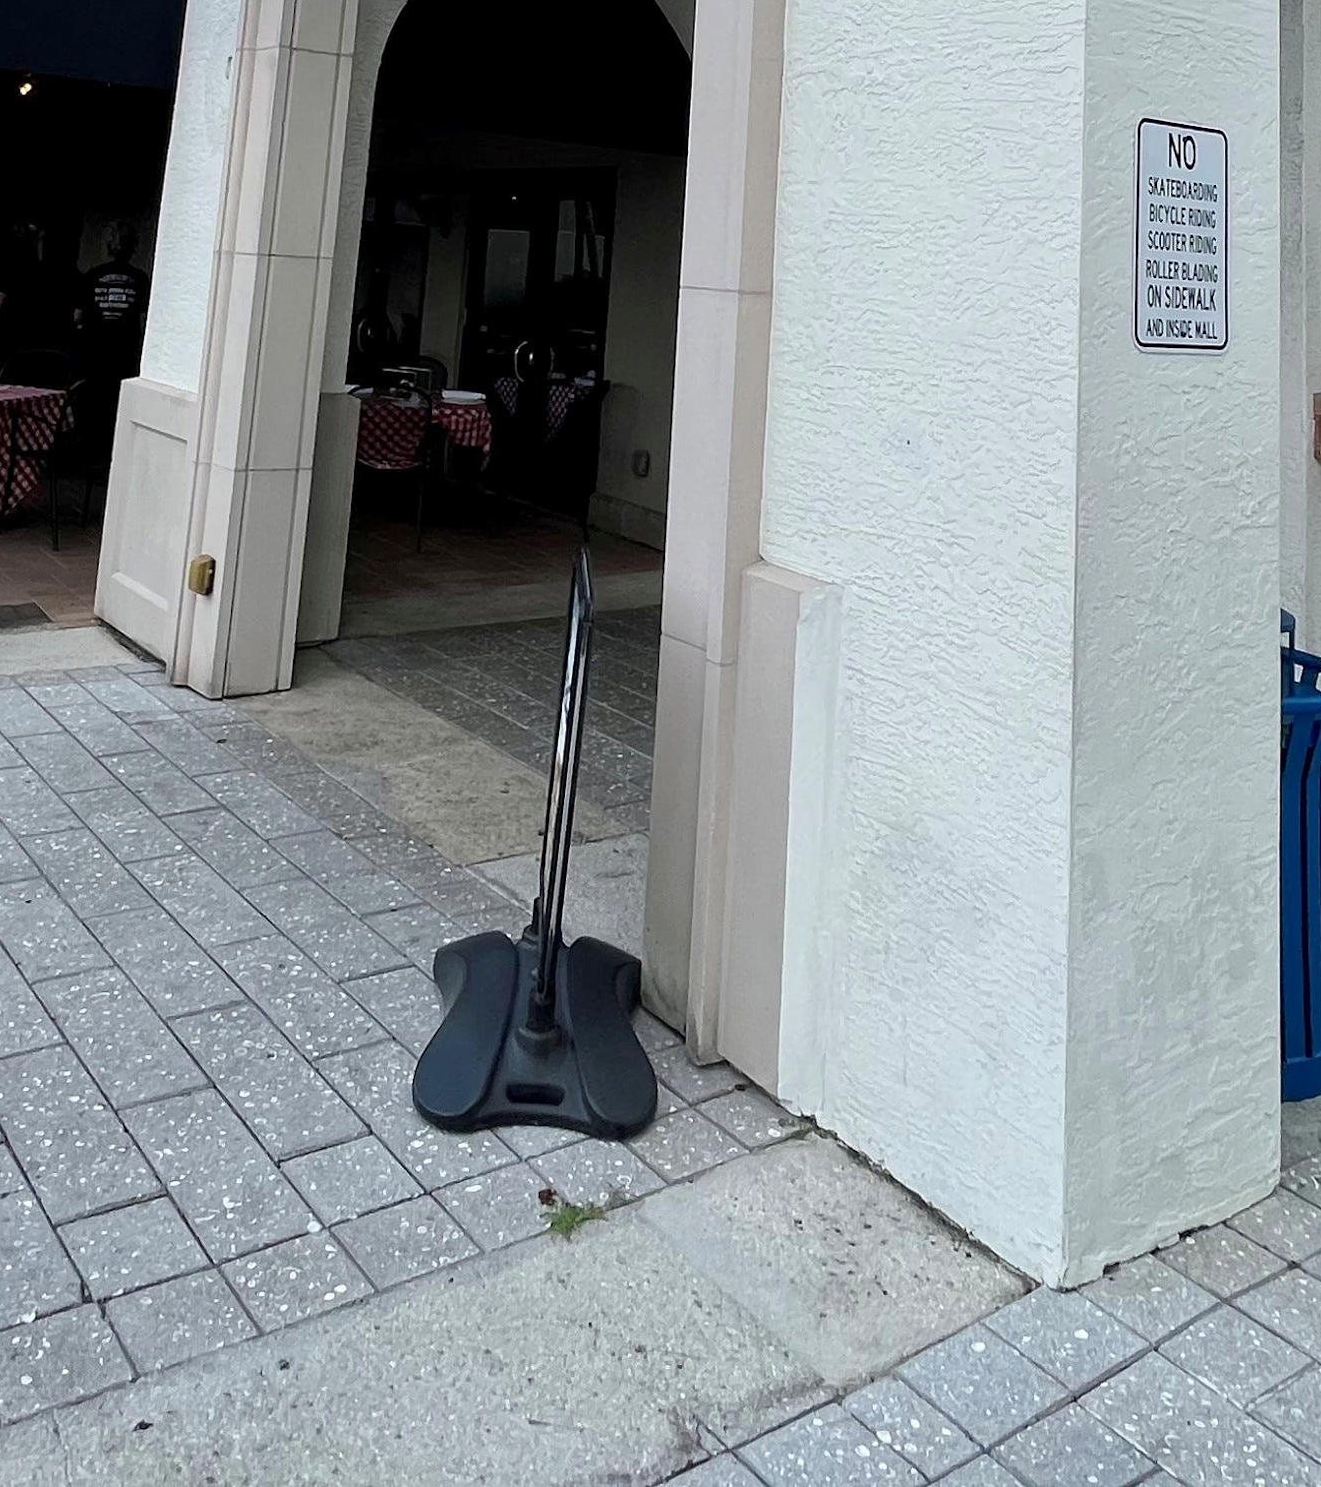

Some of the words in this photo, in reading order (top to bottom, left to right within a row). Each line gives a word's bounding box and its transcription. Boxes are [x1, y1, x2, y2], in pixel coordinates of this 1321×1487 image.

[1167, 132, 1197, 170] NO
[1148, 176, 1218, 203] SKATEBOARDING
[1149, 203, 1186, 226] BICYCLE
[1188, 207, 1217, 229] RIDING
[1147, 230, 1187, 253] SCOOTER
[1189, 234, 1217, 255] RIDING
[1145, 259, 1180, 280] ROLLER
[1182, 261, 1218, 283] BLADING
[1147, 284, 1162, 308] ON
[1164, 285, 1217, 311] SIDEWALK
[1145, 318, 1164, 337] AND
[1165, 319, 1193, 339] INSIDE
[1195, 320, 1218, 340] MALL
